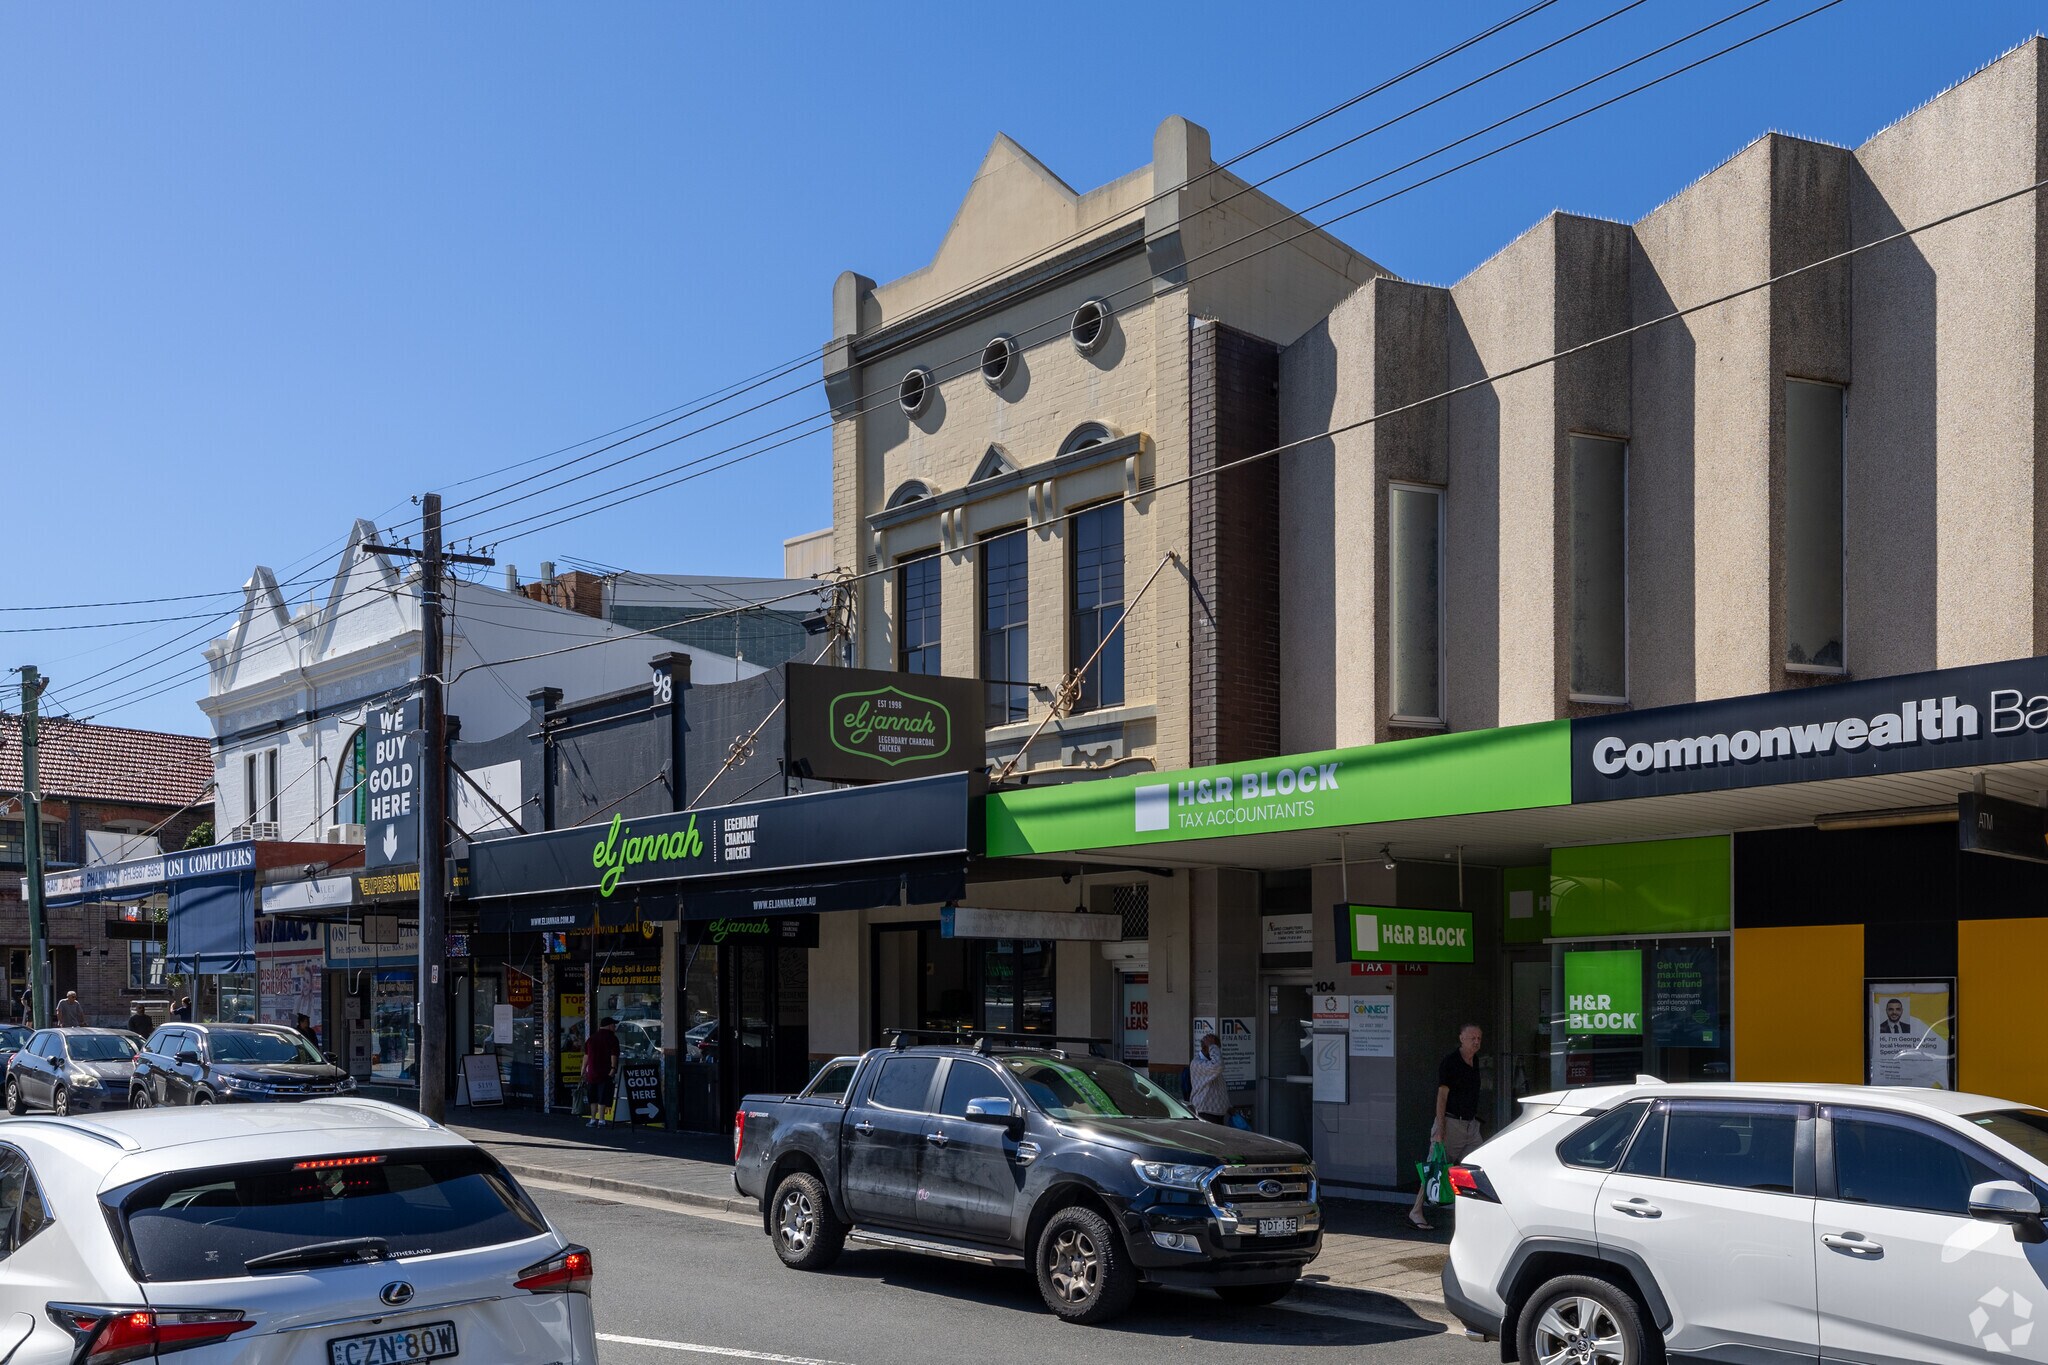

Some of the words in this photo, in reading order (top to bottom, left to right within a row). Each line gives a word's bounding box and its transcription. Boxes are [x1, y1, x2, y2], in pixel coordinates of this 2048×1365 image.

[653, 669, 672, 702] 98
[877, 700, 887, 708] EST
[888, 700, 902, 709] 1998
[380, 707, 404, 735] WE
[878, 736, 908, 745] LEGENDARY
[909, 737, 935, 747] CHARCOAL
[1592, 696, 1978, 775] Commonwealth
[376, 735, 407, 765] BUY
[878, 744, 901, 753] CHICKEN
[369, 763, 413, 793] GOLD
[1178, 776, 1233, 807] H&R
[1241, 762, 1339, 800] BLOCK
[371, 791, 411, 821] HERE
[1178, 812, 1207, 829] TAX
[1206, 800, 1315, 825] ACCOUNTANTS
[1978, 812, 1994, 831] ATM
[724, 815, 759, 832] LEGENDARY
[724, 830, 755, 846] CHARCOAL
[724, 845, 751, 861] CHICKEN
[167, 858, 184, 877] OSI
[189, 846, 252, 874] COMPUTERS
[360, 874, 397, 896] EXPRESS
[332, 926, 347, 942] OSI
[1382, 924, 1415, 945] H&R
[1418, 926, 1467, 947] BLOCK
[1359, 963, 1384, 972] TAX
[1657, 961, 1673, 970] Get
[1675, 962, 1694, 972] your
[611, 976, 629, 985] GOLD
[1657, 971, 1701, 979] maximum
[1315, 981, 1336, 992] 104
[1657, 980, 1671, 988] tax
[1673, 979, 1702, 988] refund
[1130, 1001, 1148, 1015] FOR
[1353, 1005, 1390, 1014] CONNECT
[1569, 994, 1611, 1011] H&R
[1569, 1013, 1637, 1029] BLOCK
[626, 1069, 638, 1077] WE
[640, 1068, 655, 1076] BUY
[628, 1077, 658, 1088] GOLD
[631, 1089, 656, 1100] HERE
[386, 1248, 432, 1259] SUTHERLAND
